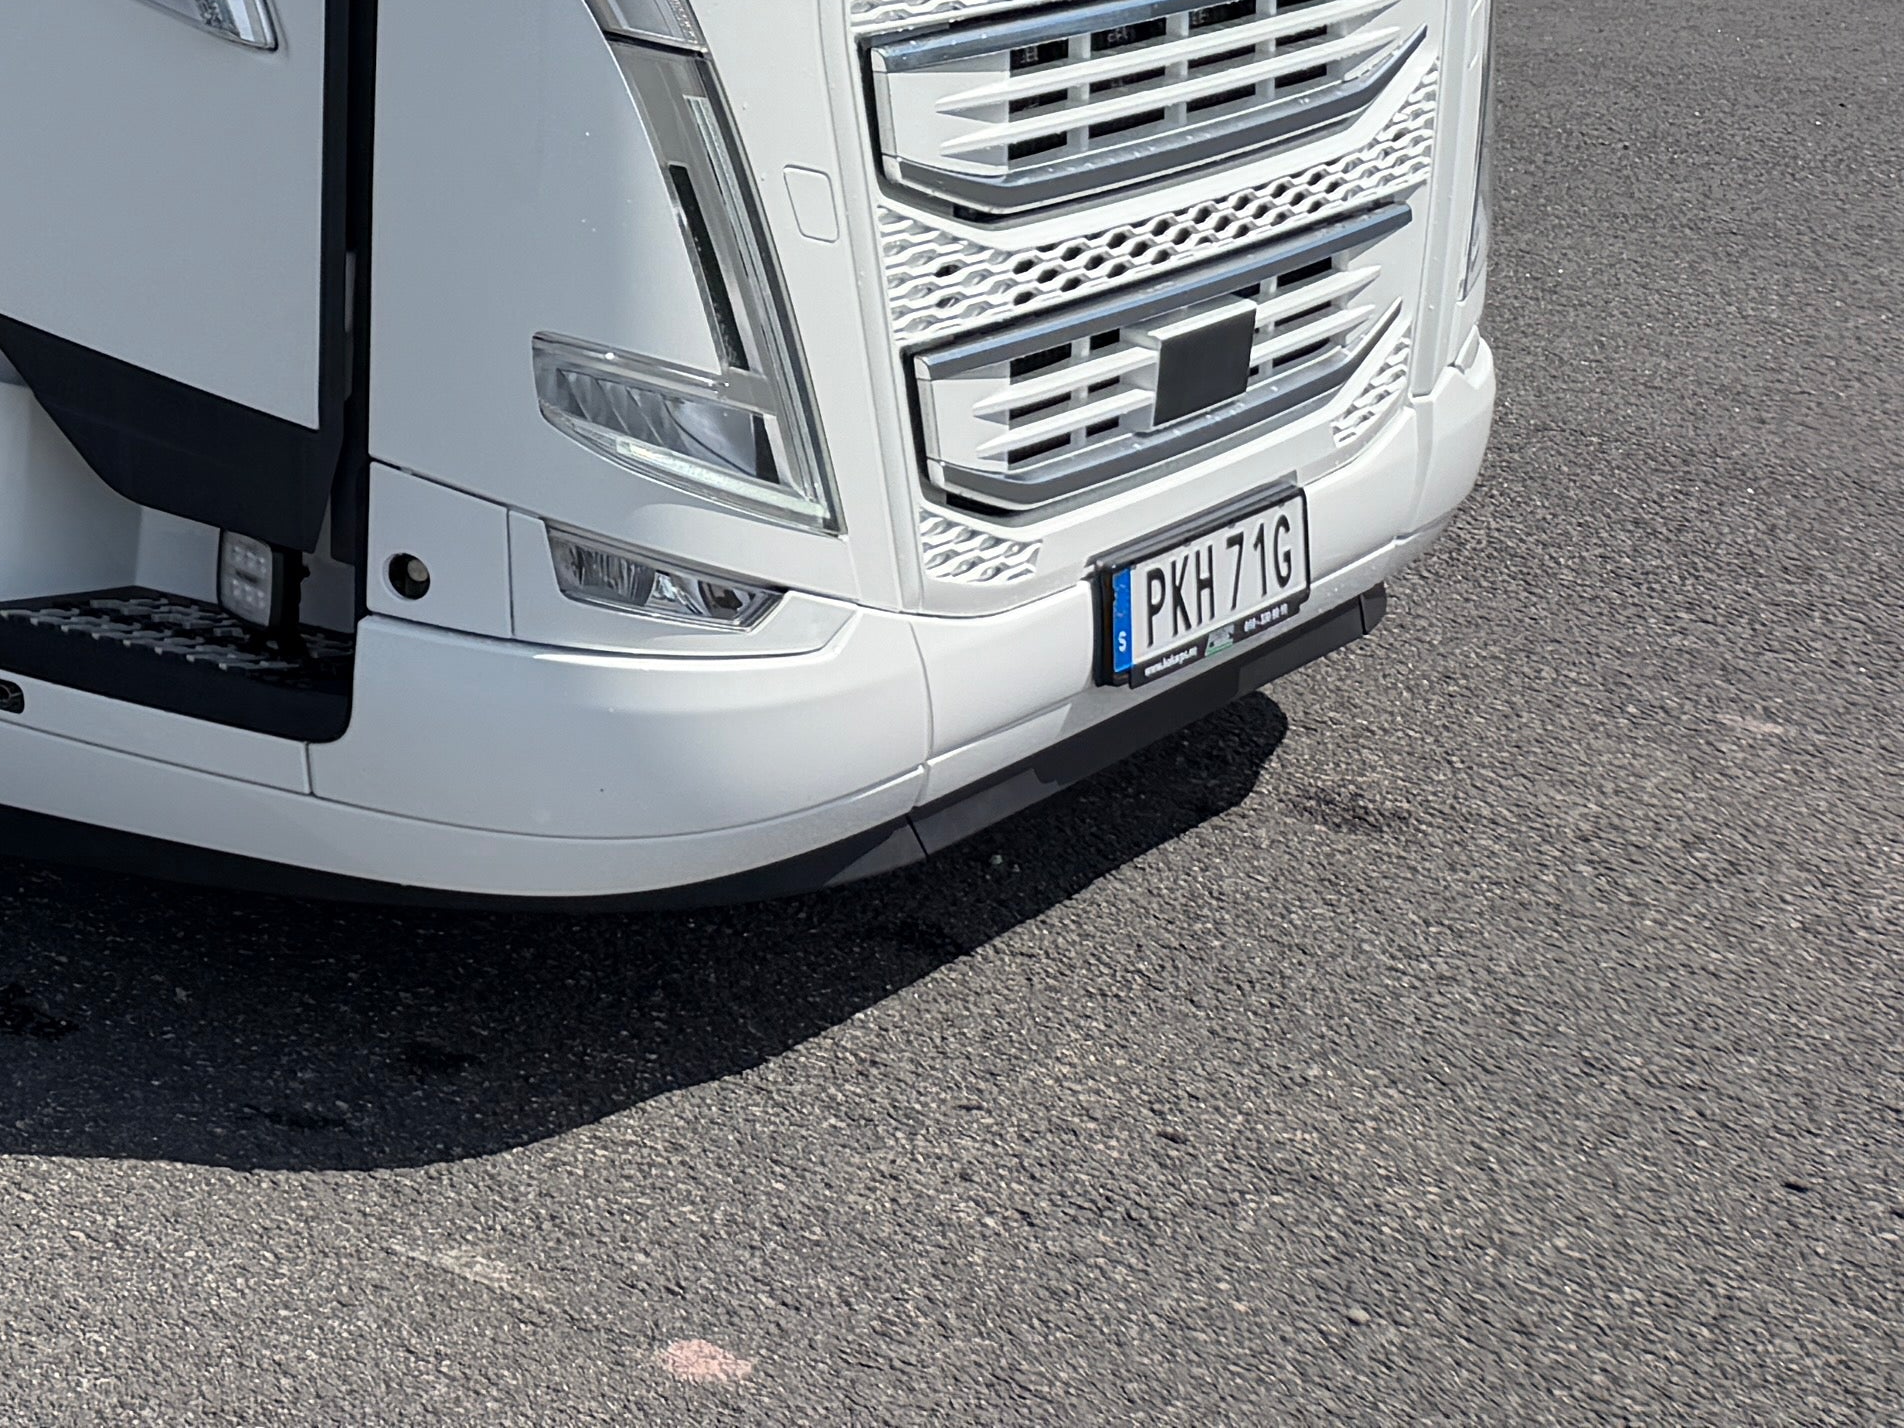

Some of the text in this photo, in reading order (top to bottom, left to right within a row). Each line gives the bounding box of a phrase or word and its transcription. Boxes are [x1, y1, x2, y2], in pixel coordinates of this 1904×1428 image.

[1145, 514, 1293, 648] PKH 71G
[1117, 631, 1128, 653] S
